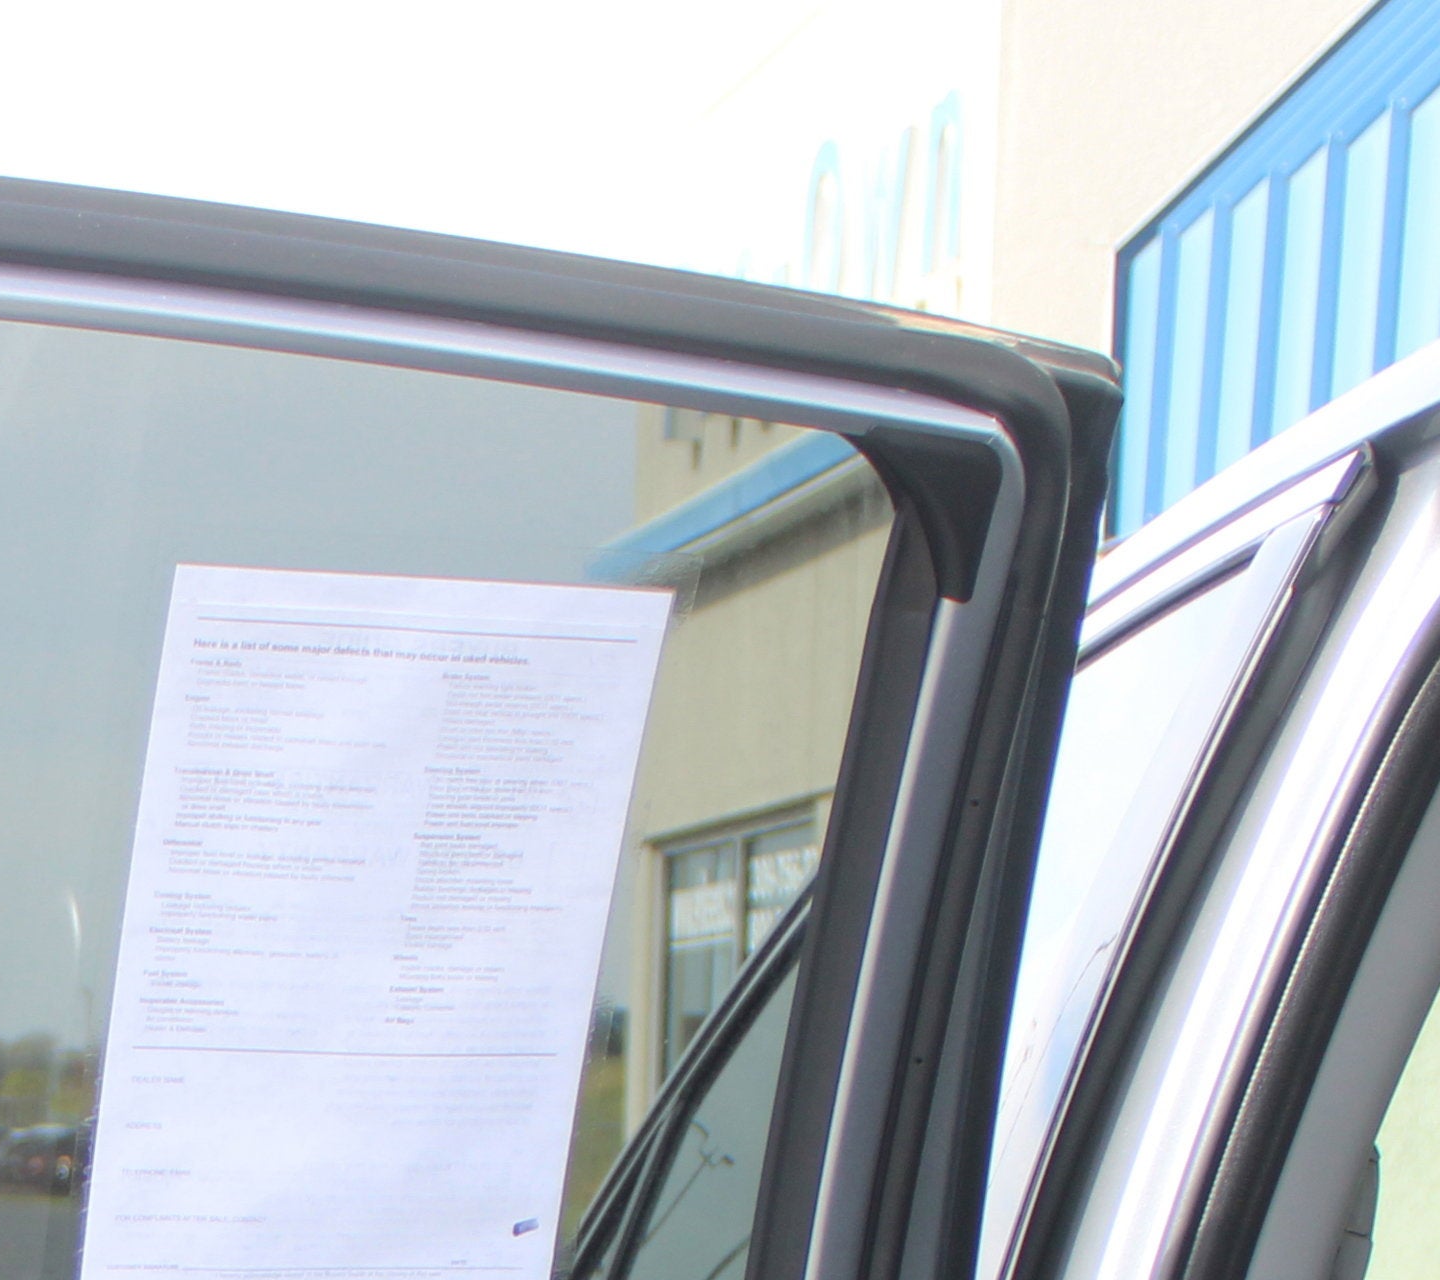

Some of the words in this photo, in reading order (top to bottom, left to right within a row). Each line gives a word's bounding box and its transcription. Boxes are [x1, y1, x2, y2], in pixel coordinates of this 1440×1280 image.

[193, 639, 217, 648] Here
[240, 642, 256, 650] list
[258, 642, 269, 651] of
[271, 644, 298, 652] some
[301, 644, 330, 655] major
[333, 646, 370, 655] defects
[372, 648, 393, 657] that
[394, 651, 416, 660] may
[419, 652, 448, 661] occur
[462, 653, 486, 663] used
